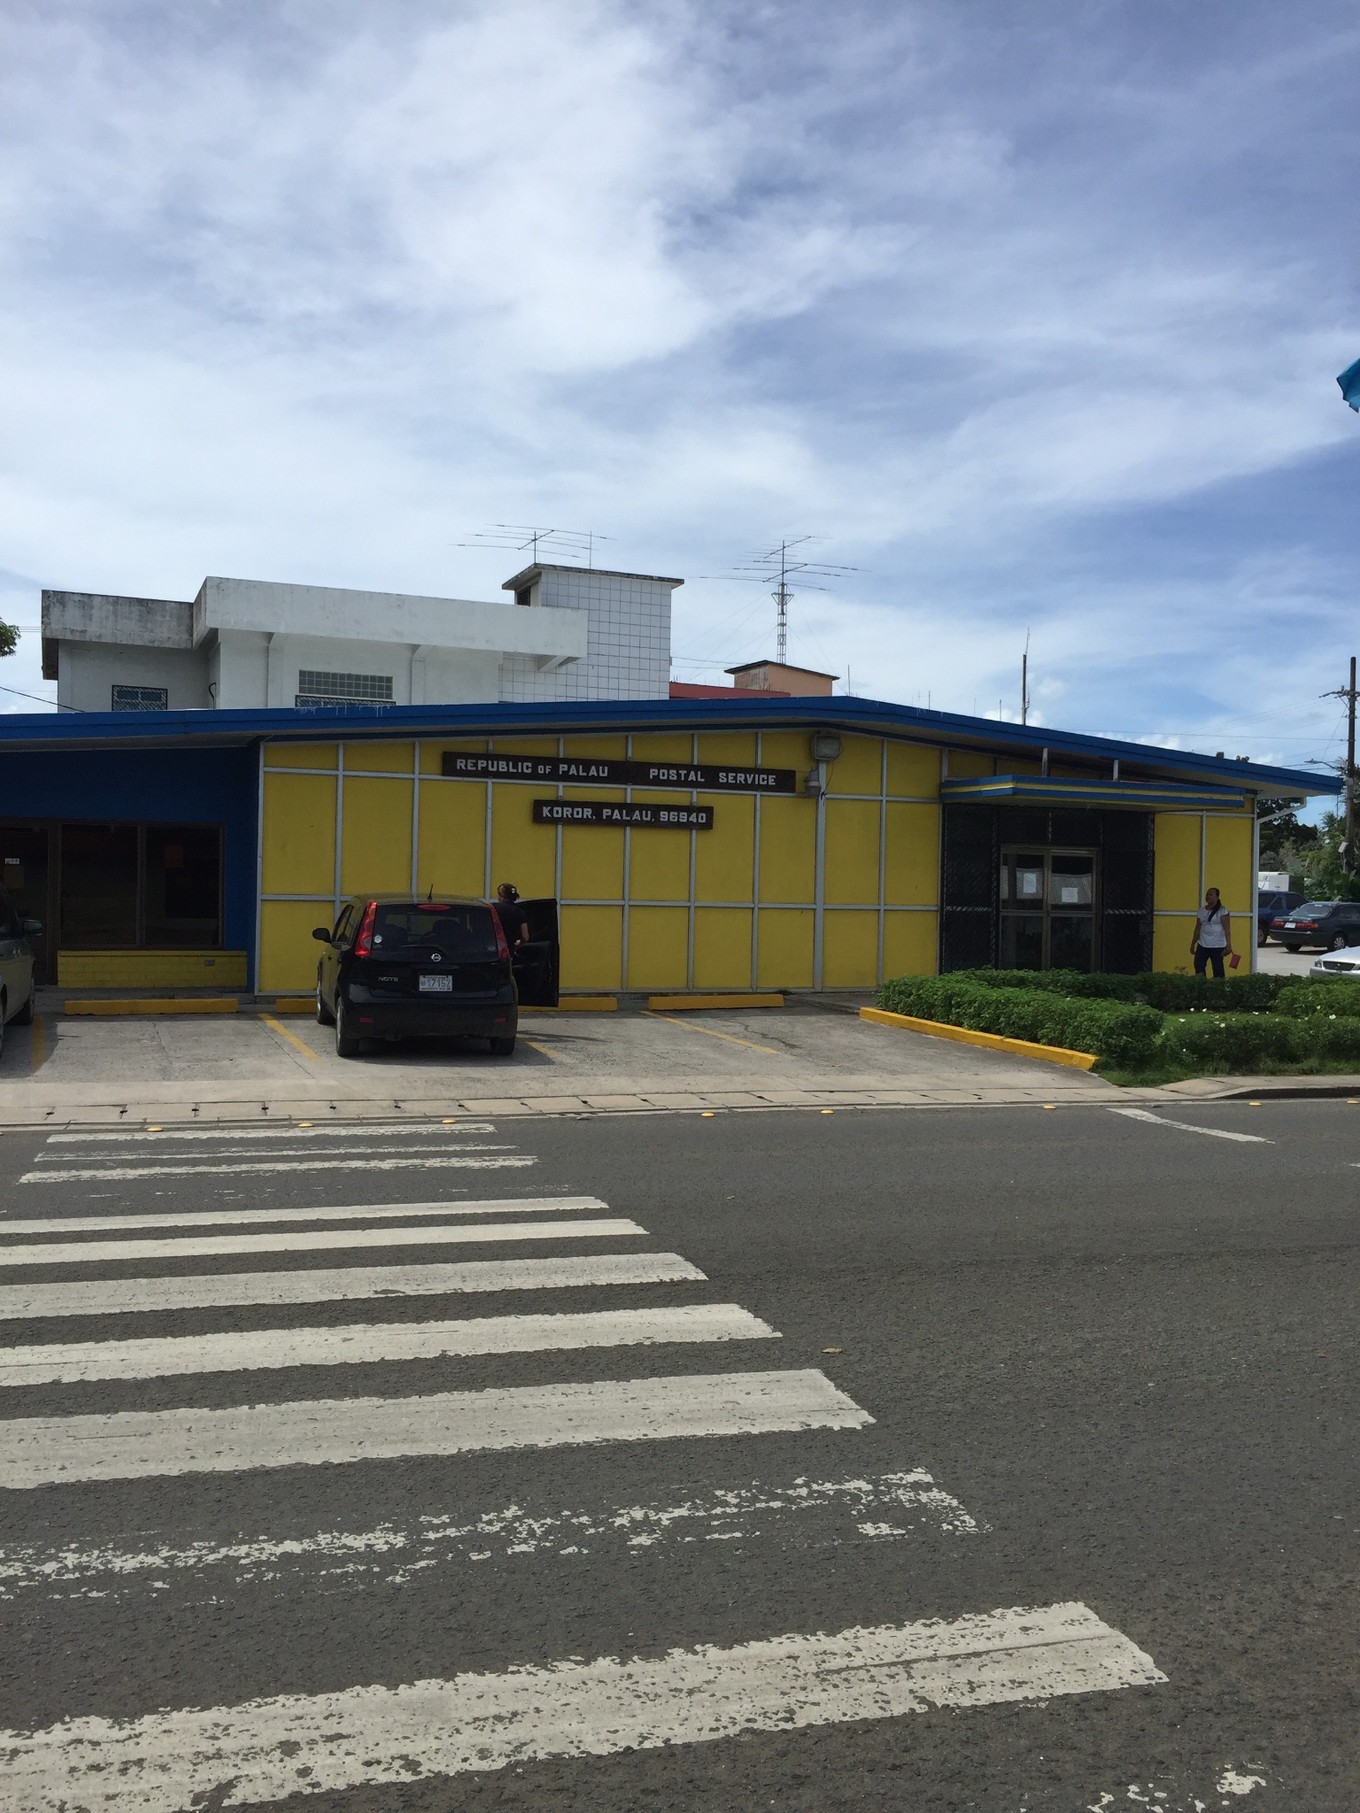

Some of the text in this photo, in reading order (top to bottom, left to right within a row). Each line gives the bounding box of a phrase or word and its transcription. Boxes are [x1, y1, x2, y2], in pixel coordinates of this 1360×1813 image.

[456, 759, 532, 774] REPUBLIC
[559, 764, 608, 777] PALAU
[649, 768, 705, 783] POSTAL
[718, 772, 777, 786] SERVICE
[659, 811, 707, 824] 96940
